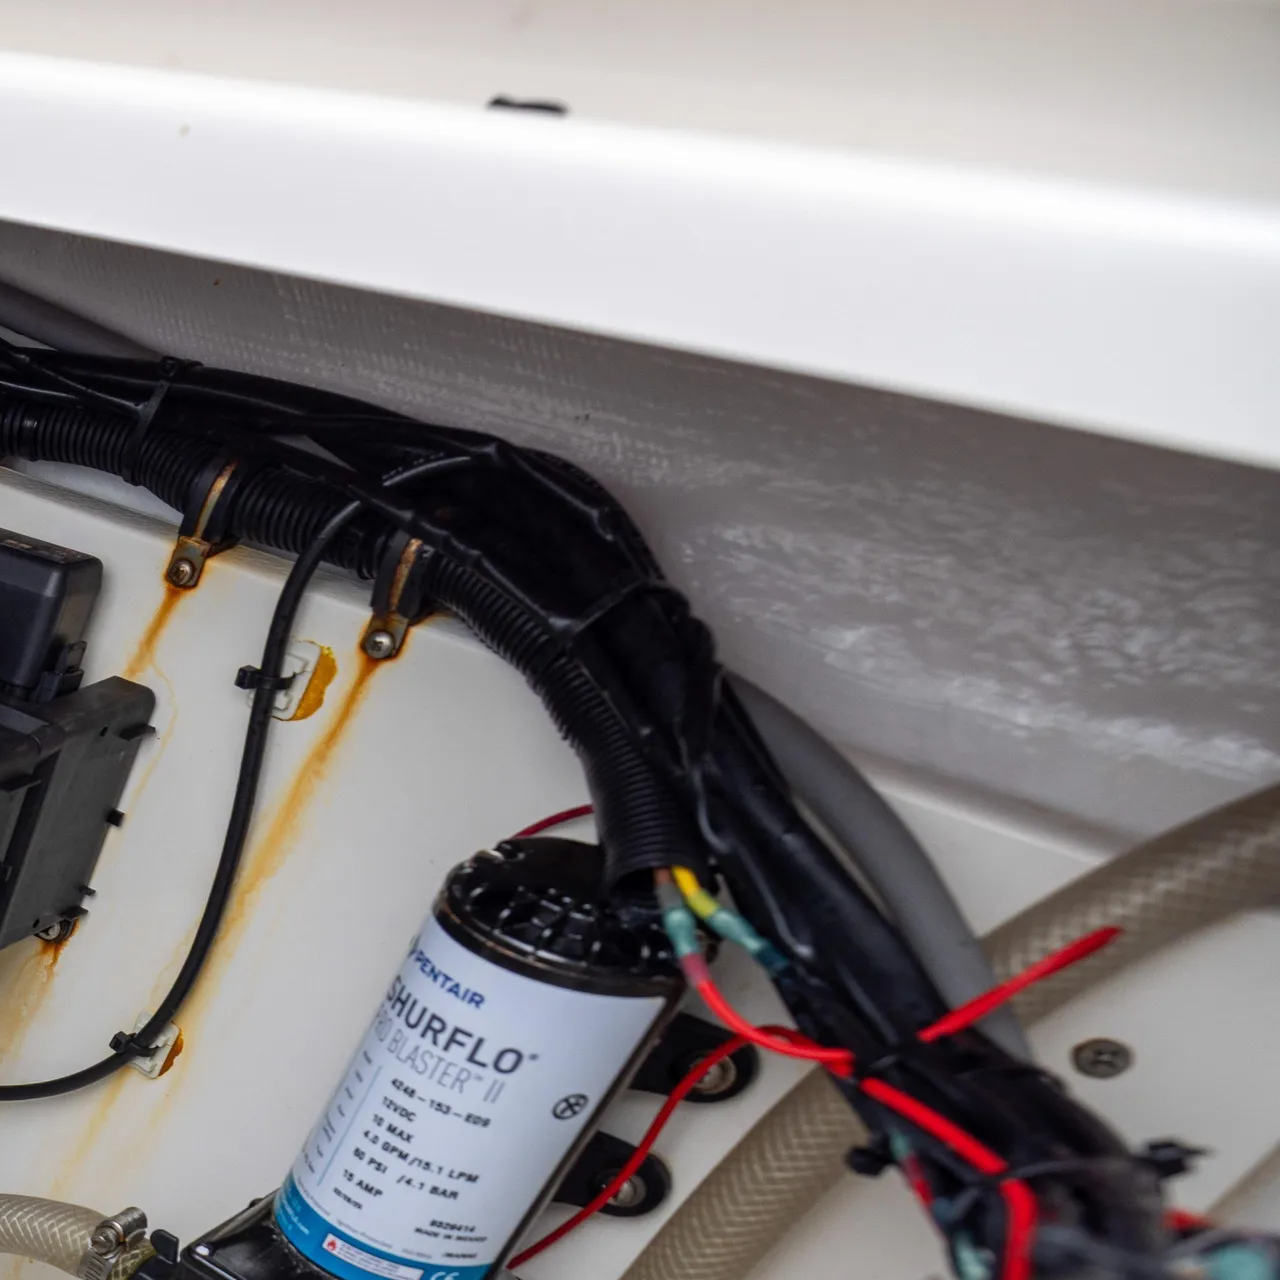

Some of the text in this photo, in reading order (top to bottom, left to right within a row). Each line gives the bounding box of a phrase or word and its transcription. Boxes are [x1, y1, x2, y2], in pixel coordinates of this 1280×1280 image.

[414, 949, 486, 1009] PENTAIR
[387, 974, 524, 1074] SHURFLO
[386, 1123, 414, 1143] MAX
[356, 1178, 383, 1197] AMP
[367, 1156, 388, 1174] PSI
[429, 1185, 460, 1201] BAR
